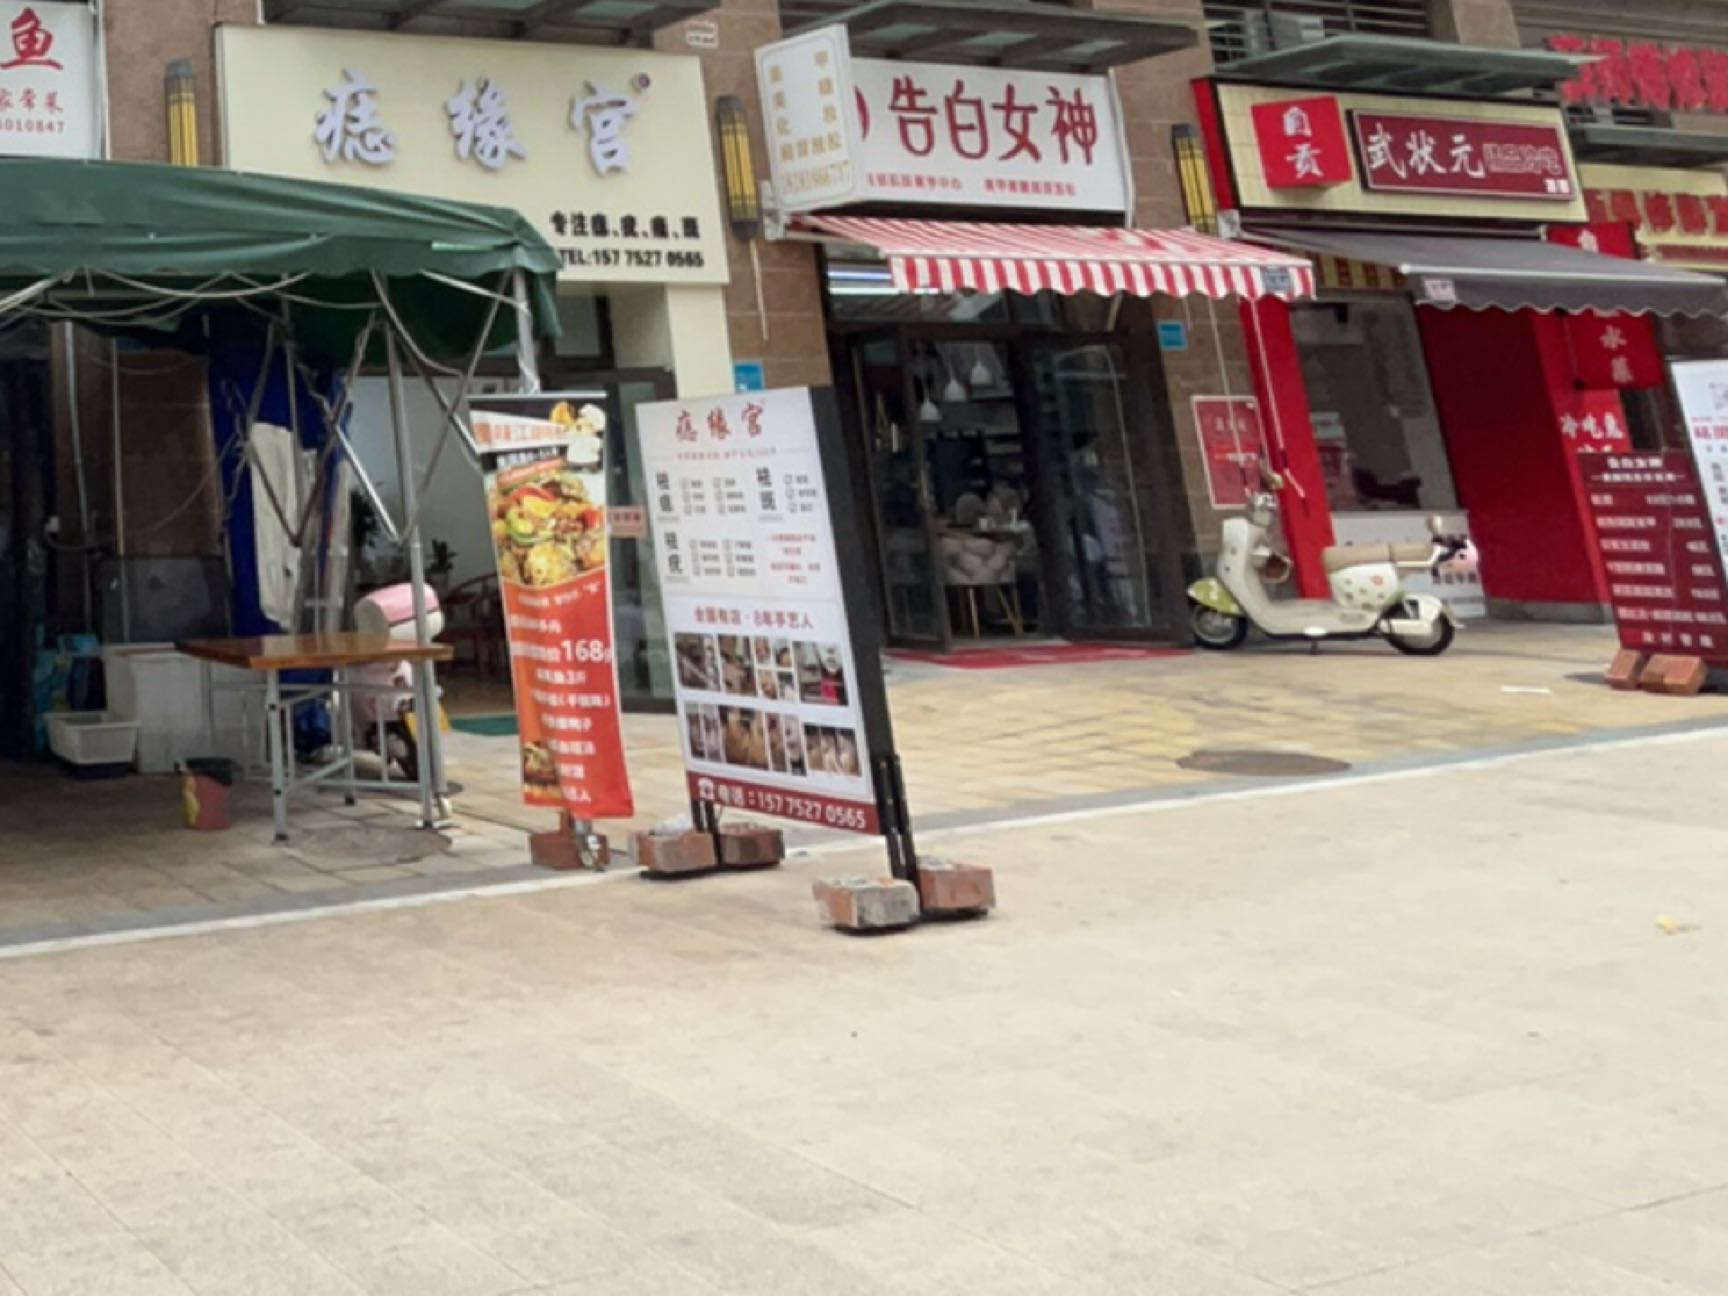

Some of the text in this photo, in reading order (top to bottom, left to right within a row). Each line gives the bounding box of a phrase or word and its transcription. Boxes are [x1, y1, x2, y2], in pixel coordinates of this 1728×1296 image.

[888, 75, 1099, 166] 告白女神
[1367, 122, 1486, 179] 武状元
